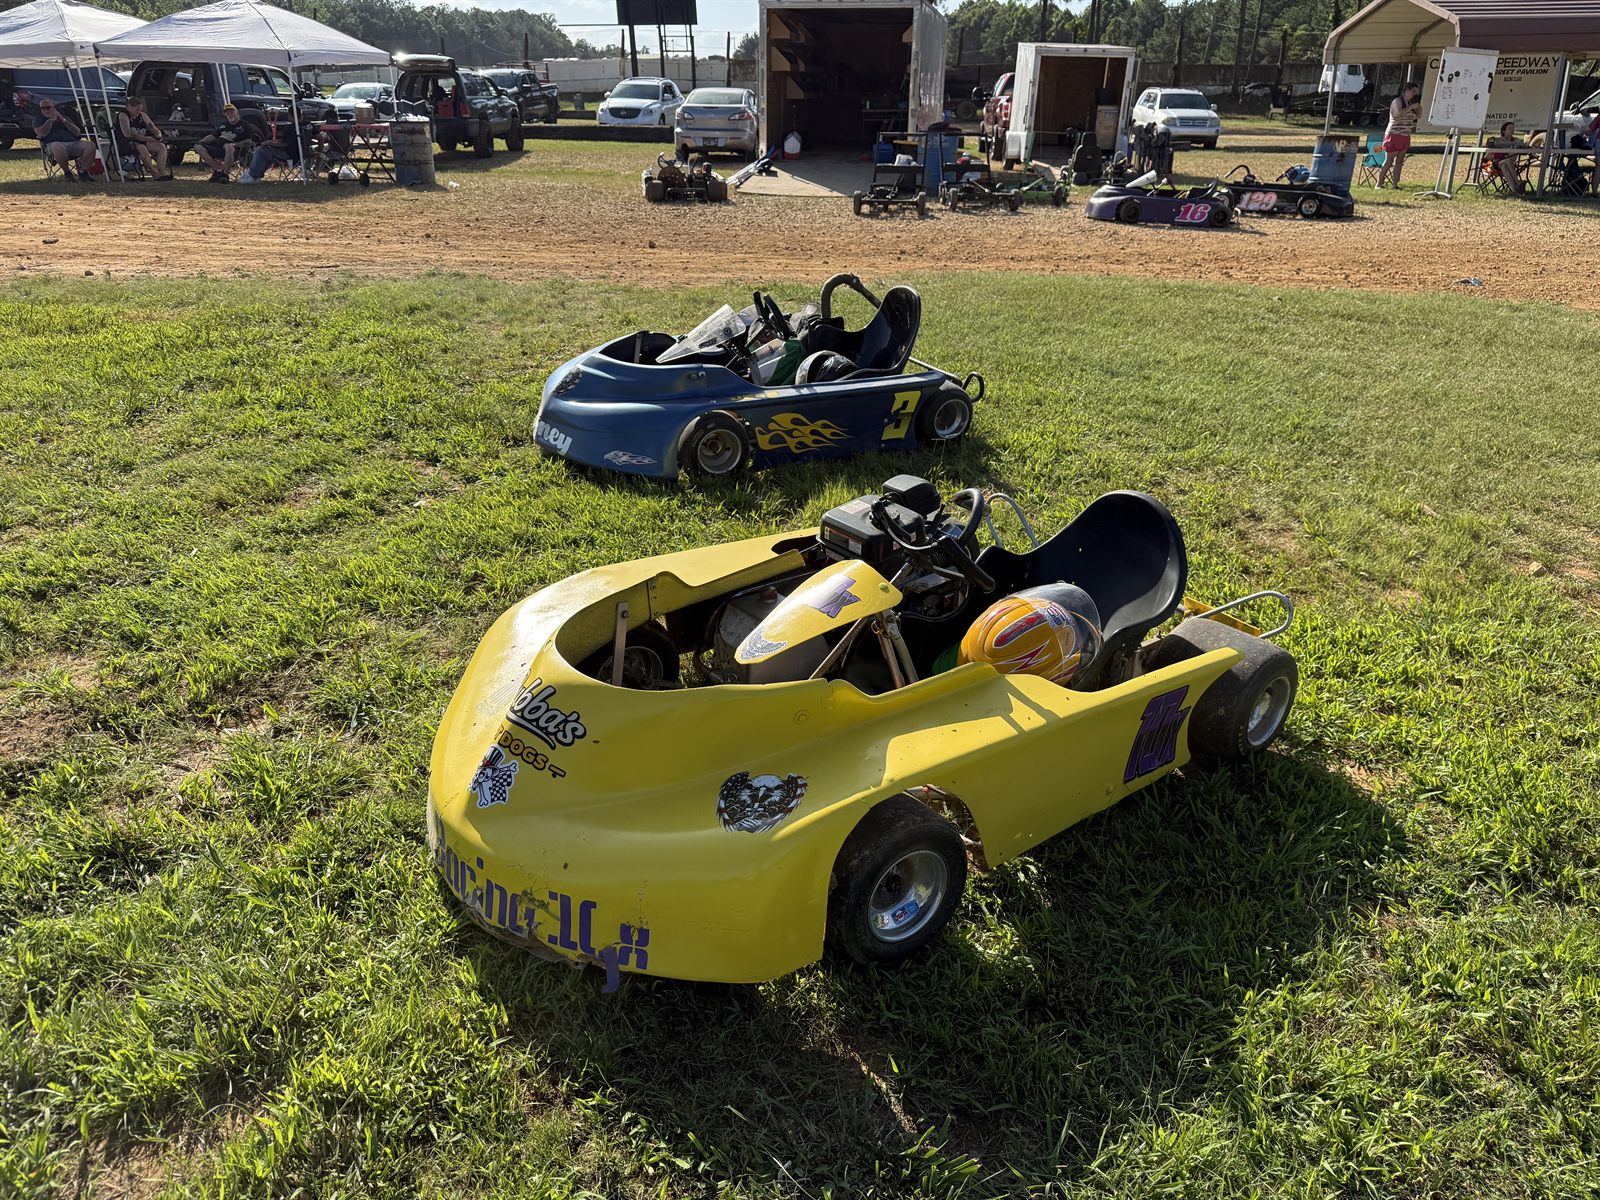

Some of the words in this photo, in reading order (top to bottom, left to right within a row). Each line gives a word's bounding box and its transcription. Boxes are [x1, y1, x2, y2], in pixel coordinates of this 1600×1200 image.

[1496, 57, 1560, 68] PEEDWAY
[1175, 203, 1211, 223] 16
[1236, 191, 1278, 211] 129
[881, 391, 921, 440] 3
[537, 421, 573, 456] ney
[509, 675, 587, 748] bba's
[498, 730, 549, 771] DOGS
